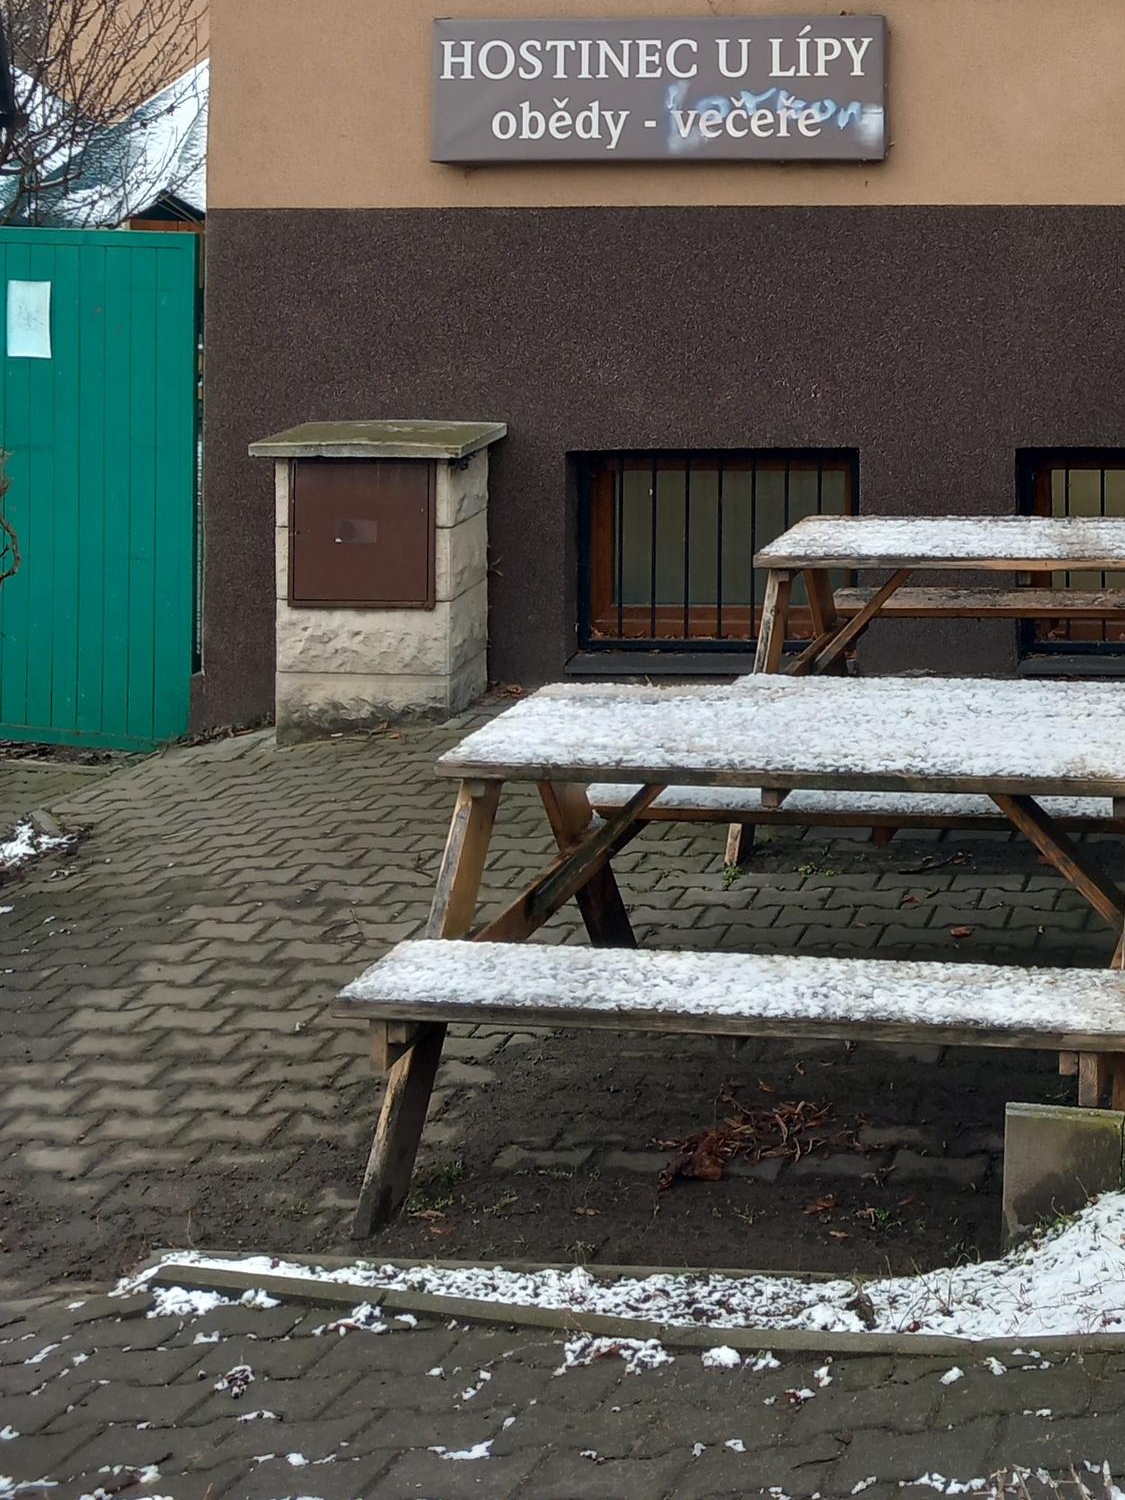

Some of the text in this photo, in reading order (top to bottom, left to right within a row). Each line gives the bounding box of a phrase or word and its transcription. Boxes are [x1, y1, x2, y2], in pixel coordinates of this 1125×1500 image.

[439, 24, 874, 81] HOSTINEC U LÍPY
[491, 97, 631, 150] obědy
[670, 95, 822, 139] večeře
